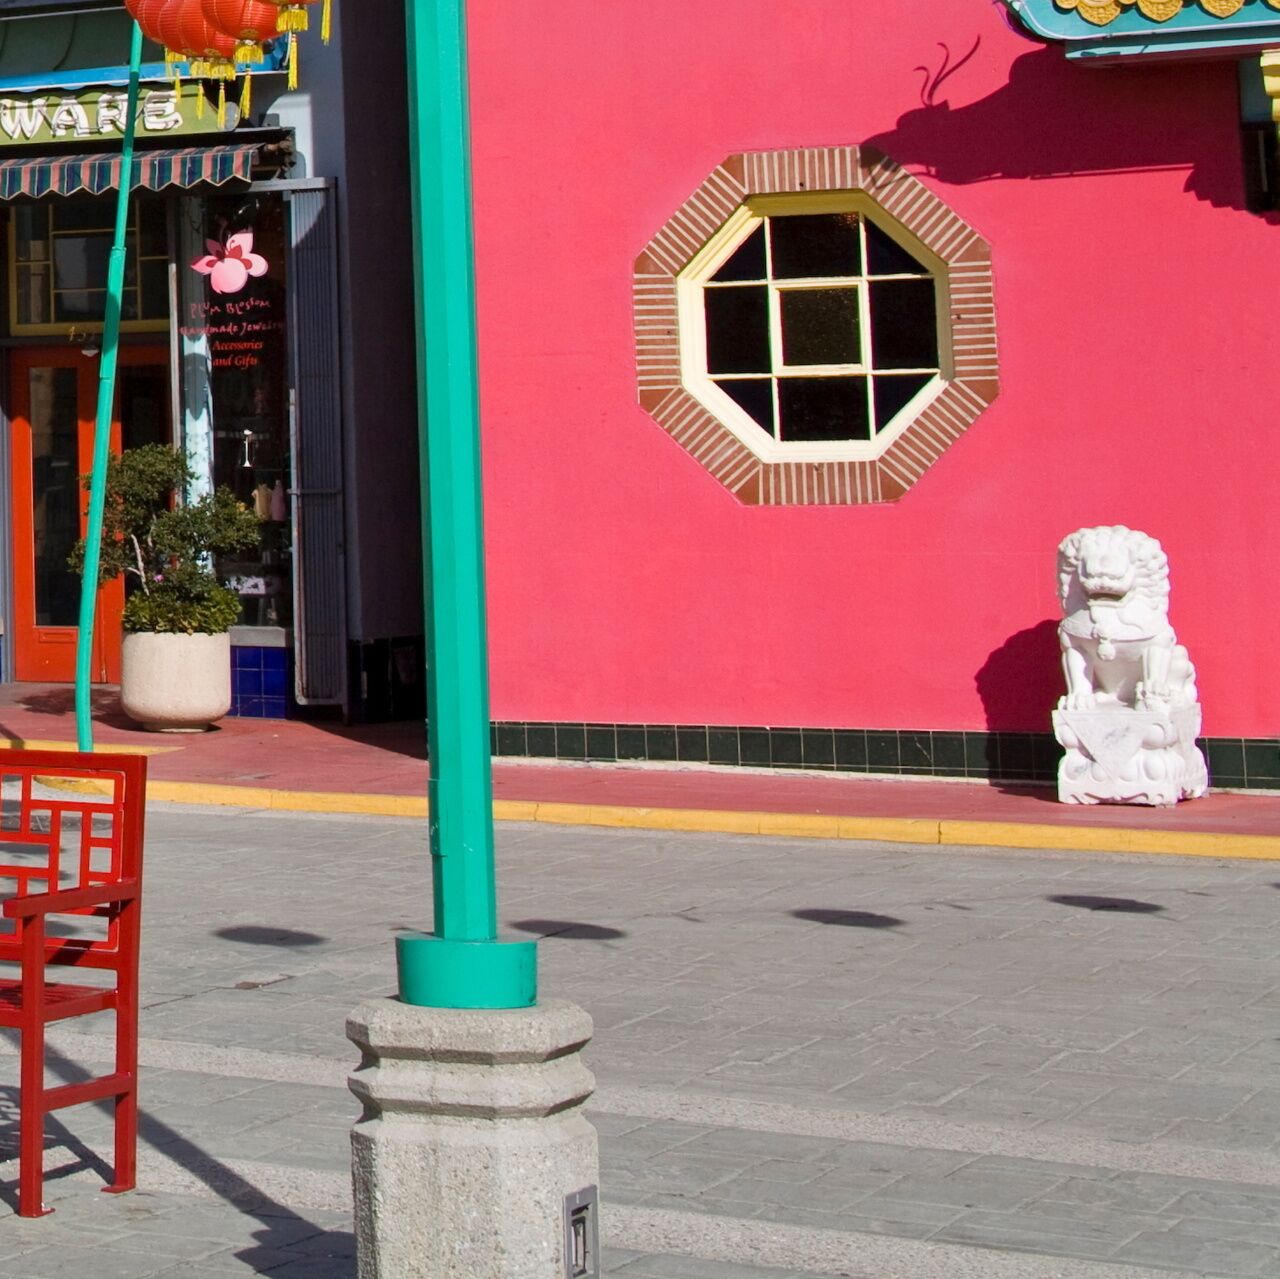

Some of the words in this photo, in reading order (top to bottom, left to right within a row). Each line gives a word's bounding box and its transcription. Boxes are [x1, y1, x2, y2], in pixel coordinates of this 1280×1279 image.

[212, 339, 264, 351] Accessories
[212, 354, 232, 367] and
[234, 353, 258, 370] Gifts
